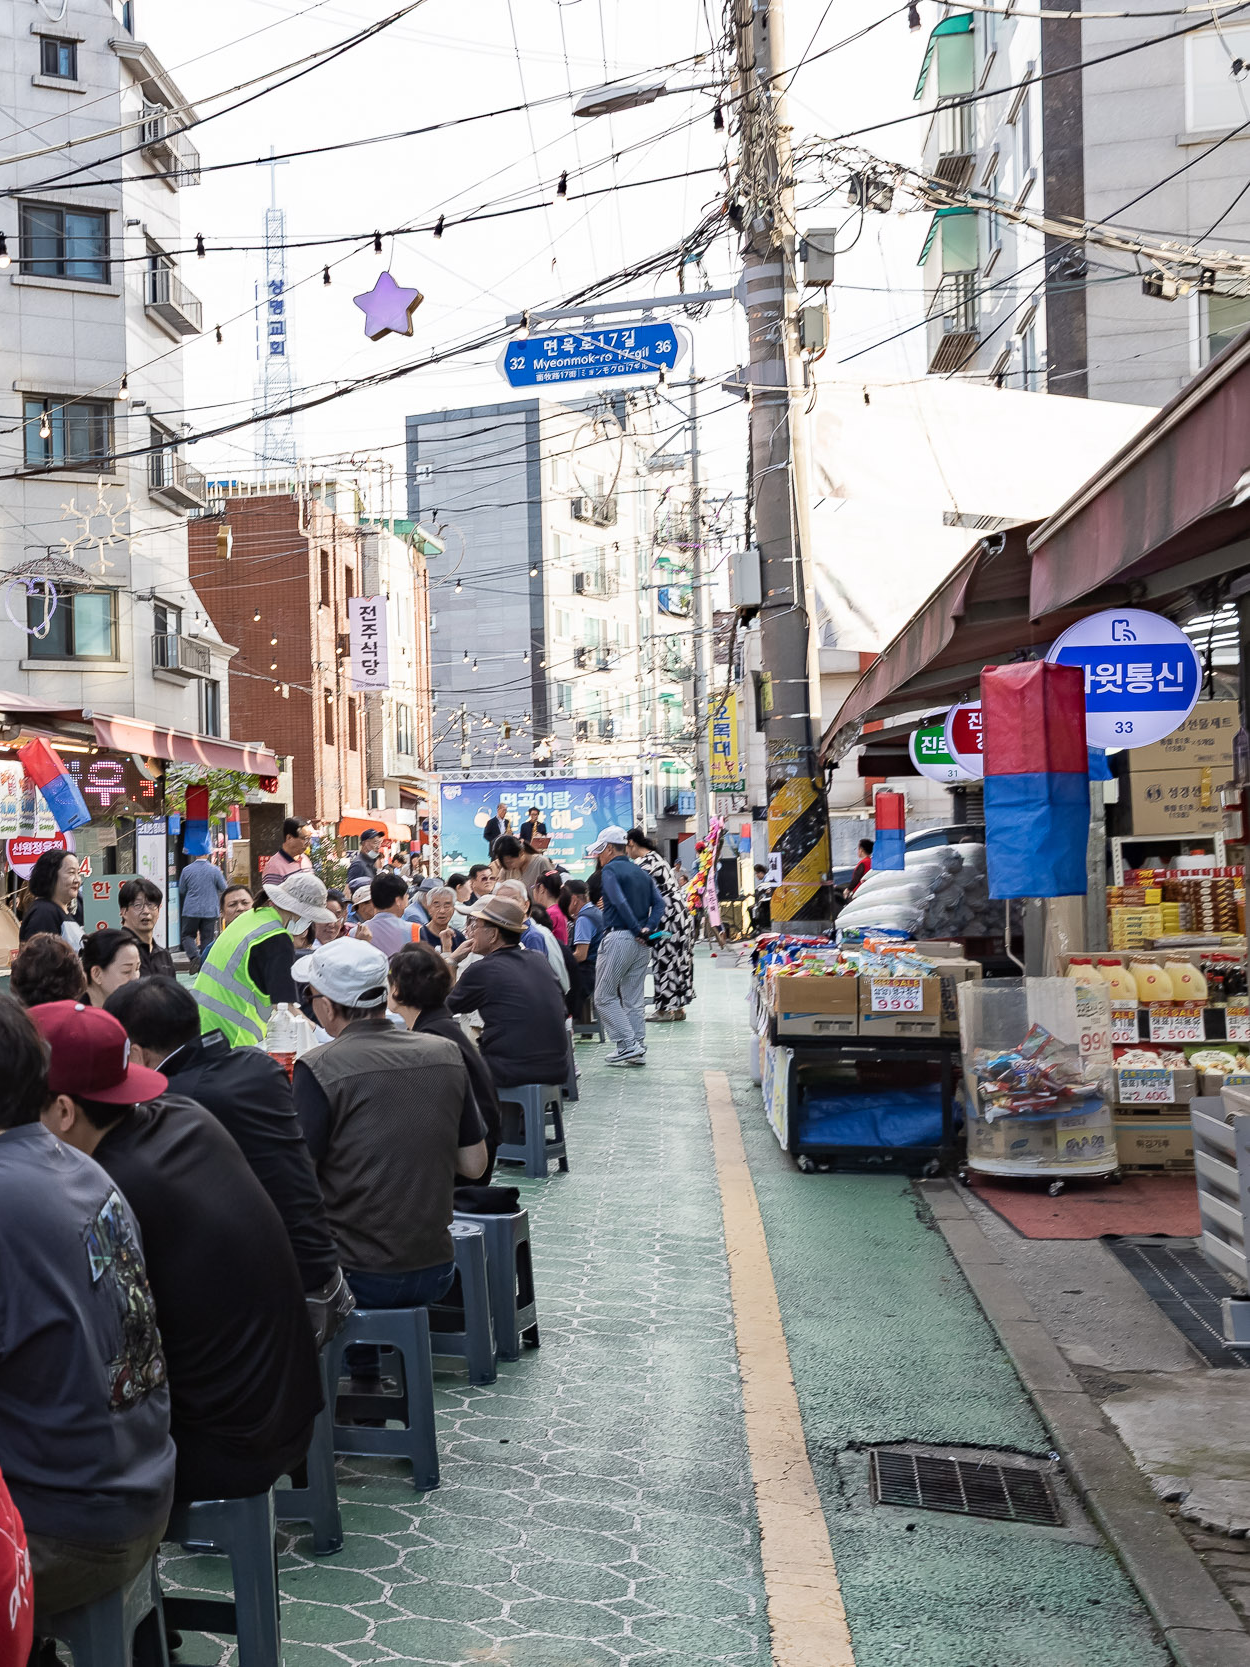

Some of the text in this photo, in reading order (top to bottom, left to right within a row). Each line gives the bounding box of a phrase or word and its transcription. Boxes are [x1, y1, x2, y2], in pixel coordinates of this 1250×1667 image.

[543, 329, 636, 357] 면목로17길
[655, 340, 672, 354] 36
[509, 357, 526, 370] 32
[533, 346, 650, 371] Myeonmok-ro 17-gil
[359, 605, 380, 676] 전주식당
[1115, 721, 1133, 734] 33
[948, 769, 959, 778] 31
[499, 790, 571, 811] 면곡이랑
[877, 999, 914, 1010] 990
[1133, 1091, 1168, 1102] 2,400
